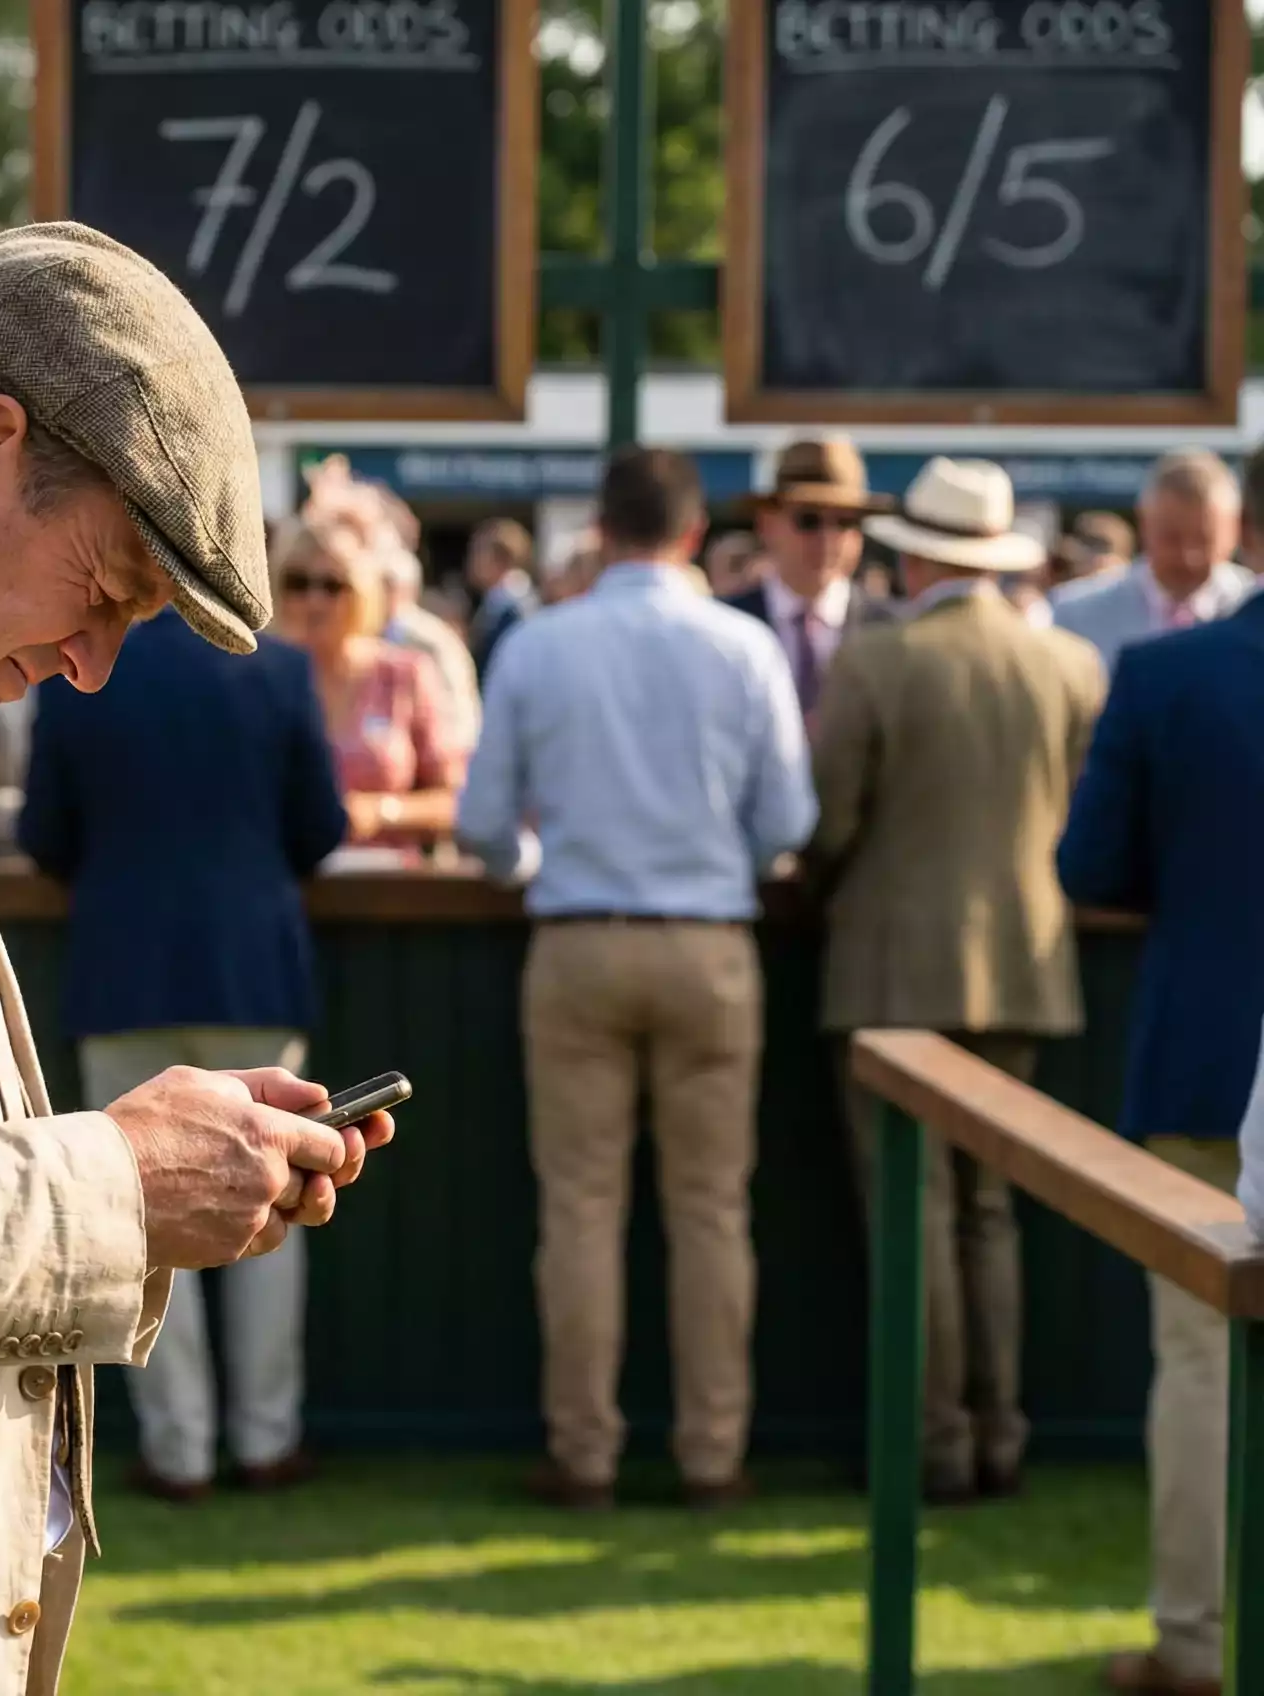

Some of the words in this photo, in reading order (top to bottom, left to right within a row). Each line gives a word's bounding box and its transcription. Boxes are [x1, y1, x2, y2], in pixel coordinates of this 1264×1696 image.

[1021, 0, 1172, 53] ODDS
[158, 99, 399, 316] 7/2
[845, 92, 1116, 291] 6/5
